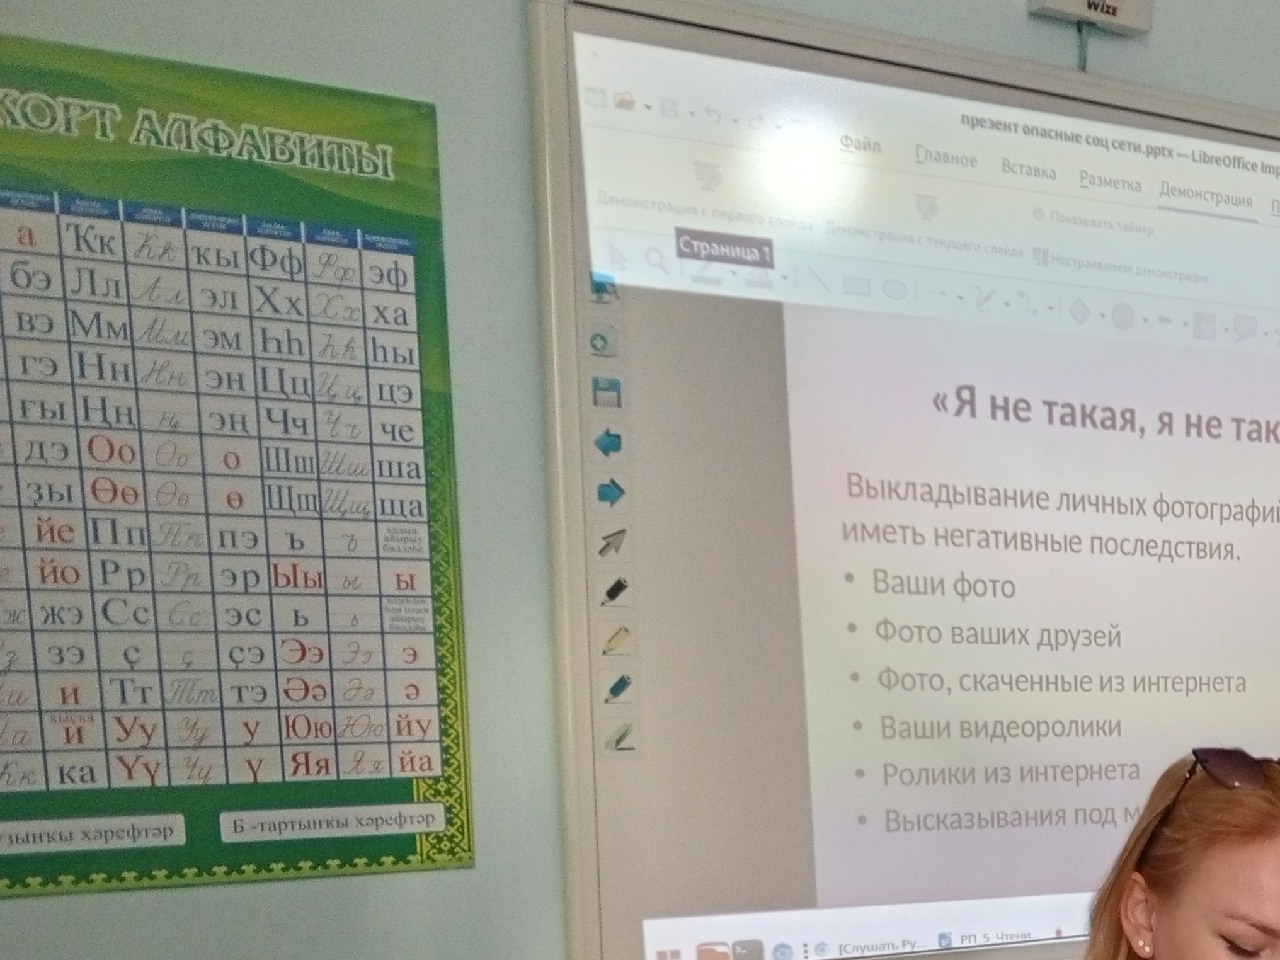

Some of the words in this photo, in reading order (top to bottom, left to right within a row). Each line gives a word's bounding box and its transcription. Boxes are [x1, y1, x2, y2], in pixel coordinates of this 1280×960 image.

[129, 107, 394, 181] АЛФАВИТЫ
[839, 133, 882, 153] Файл
[961, 113, 1019, 134] презент
[1022, 124, 1083, 144] опасные
[1085, 135, 1110, 152] соц
[1112, 138, 1174, 160] сети.pptx
[1191, 149, 1258, 172] LibreOffice
[915, 143, 978, 169] Главное
[1002, 156, 1057, 181] Вставка
[1080, 168, 1142, 193] Разметка
[1159, 179, 1253, 209] Демонстрация
[17, 226, 36, 247] а
[679, 235, 760, 263] Страница
[763, 247, 771, 262] 1
[10, 260, 51, 290] бэ
[250, 244, 302, 282] Фф
[369, 259, 408, 292] эф
[71, 267, 121, 298] Лл
[201, 288, 238, 309] эл
[255, 285, 304, 317] Хх
[16, 312, 54, 334] вэ
[70, 309, 129, 341] Мм
[372, 305, 409, 326] ха
[203, 328, 242, 351] эм
[19, 355, 58, 377] гэ
[77, 351, 131, 383] Нн
[205, 369, 246, 392] эн
[261, 366, 312, 399] Цц
[378, 383, 413, 405] цэ
[265, 407, 309, 436] Чч
[933, 384, 977, 419] «Я
[989, 394, 1032, 423] не
[1041, 399, 1147, 440] такая,
[1157, 411, 1174, 436] я
[1185, 412, 1224, 440] не
[380, 422, 414, 443] че
[25, 440, 69, 464] дэ
[87, 434, 136, 464] Оо
[265, 445, 315, 475] Шш
[377, 458, 423, 480] ша
[91, 475, 140, 505] Өө
[226, 491, 244, 509] ө
[267, 484, 320, 518] Щщ
[847, 471, 1050, 511] Выкладывание
[1056, 492, 1148, 518] личных
[379, 497, 424, 518] ща
[36, 516, 75, 544] йе
[90, 517, 147, 546] Пп
[218, 529, 259, 549] пэ
[285, 532, 305, 550] ъ
[842, 520, 926, 546] иметь
[934, 525, 1083, 554] негативные
[1090, 535, 1242, 564] последствия.
[39, 557, 81, 585] йо
[220, 568, 261, 594] эр
[272, 562, 324, 590] Ыы
[395, 573, 417, 591] ы
[872, 567, 946, 596] Ваши
[953, 570, 1016, 603] фото
[40, 606, 83, 625] жэ
[101, 597, 150, 626] Сс
[225, 607, 262, 626] эс
[292, 608, 309, 627] ь
[875, 617, 943, 644] Фото
[951, 625, 1031, 646] ваших
[1036, 623, 1122, 652] друзей
[48, 645, 85, 665] зэ
[281, 638, 324, 664] Ээ
[402, 647, 418, 664] э
[109, 677, 152, 705] Тт
[230, 684, 268, 703] тэ
[283, 676, 328, 701] Әә
[405, 682, 420, 700] ә
[878, 665, 953, 697] Фото,
[959, 673, 1094, 693] скаченные
[1099, 674, 1126, 693] из
[1131, 672, 1247, 698] интернета
[60, 686, 79, 705] и
[64, 726, 84, 745] и
[112, 715, 157, 749] Уу
[242, 720, 261, 747] у
[284, 713, 333, 740] Юю
[395, 713, 432, 741] йу
[881, 715, 952, 740] Ваши
[960, 719, 1122, 744] видеоролики
[58, 764, 97, 785] ка
[290, 751, 331, 776] Яя
[399, 750, 434, 773] йа
[883, 762, 976, 788] Ролики
[984, 765, 1012, 785] из
[1019, 760, 1142, 787] интернета
[232, 818, 245, 834] Б
[355, 811, 436, 831] хәрефтәр
[885, 807, 1067, 833] Высказывания
[1074, 806, 1118, 829] под
[81, 823, 174, 845] хәрефтәр
